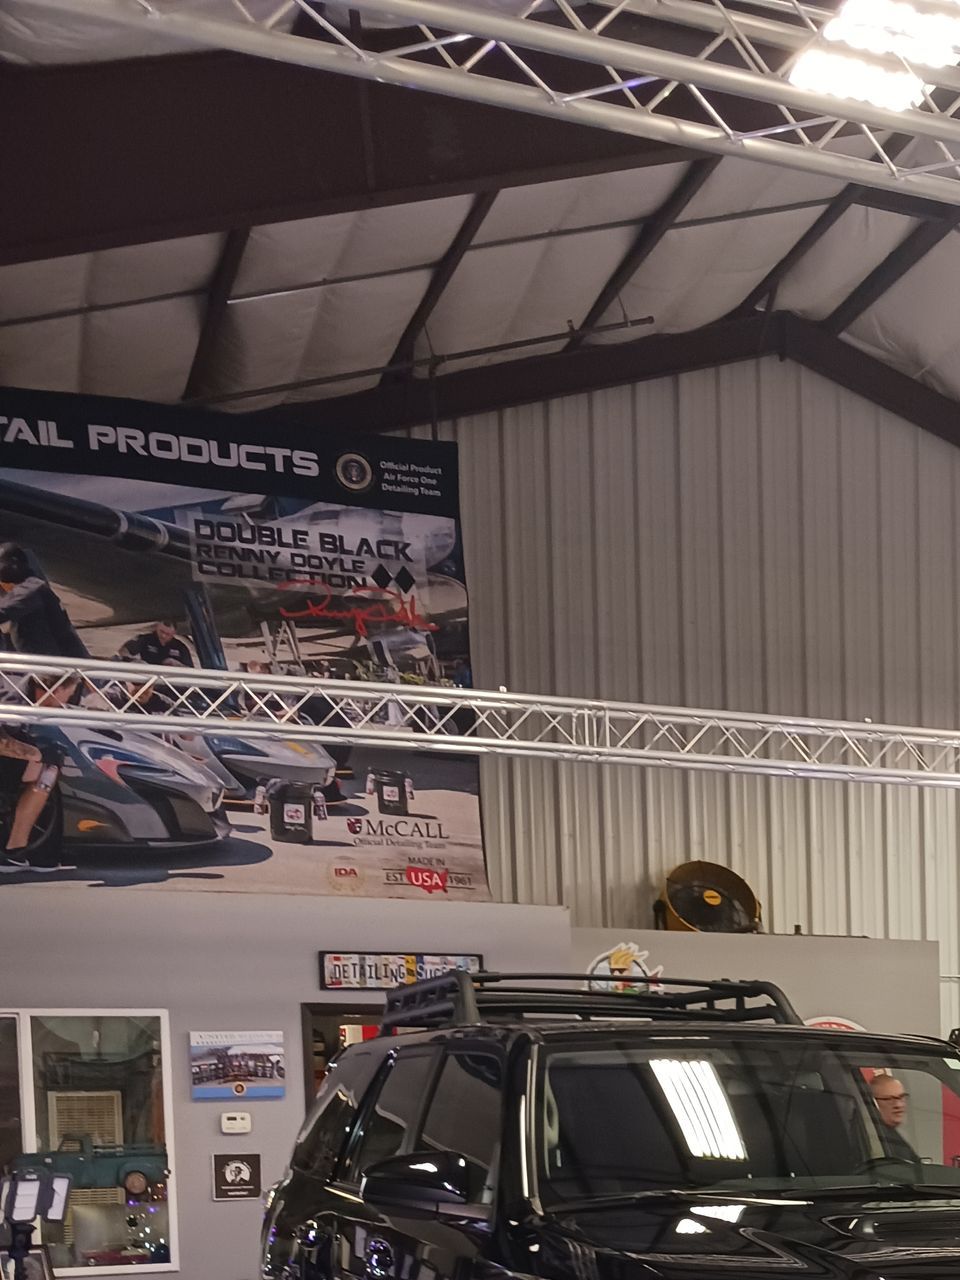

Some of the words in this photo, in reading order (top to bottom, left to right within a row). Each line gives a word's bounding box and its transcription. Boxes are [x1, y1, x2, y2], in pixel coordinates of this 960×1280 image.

[87, 424, 320, 477] PRODUCTS
[380, 460, 409, 471] Official
[410, 464, 442, 475] Product
[383, 472, 396, 480] Air
[397, 473, 419, 483] Force
[420, 476, 437, 485] One
[381, 483, 419, 496] Detailing
[420, 487, 441, 496] Team
[193, 518, 309, 549] DOUBLE
[319, 532, 414, 563] BLACK
[196, 543, 281, 565] RENNY
[290, 553, 366, 575] DOYLE
[198, 560, 367, 591] COLLECTION
[366, 819, 450, 839] McCALL
[408, 857, 433, 866] MADE
[435, 858, 446, 866] IN
[334, 868, 358, 878] IDA
[385, 872, 403, 882] EST
[411, 871, 443, 887] USA
[333, 963, 405, 983] DETAILING
